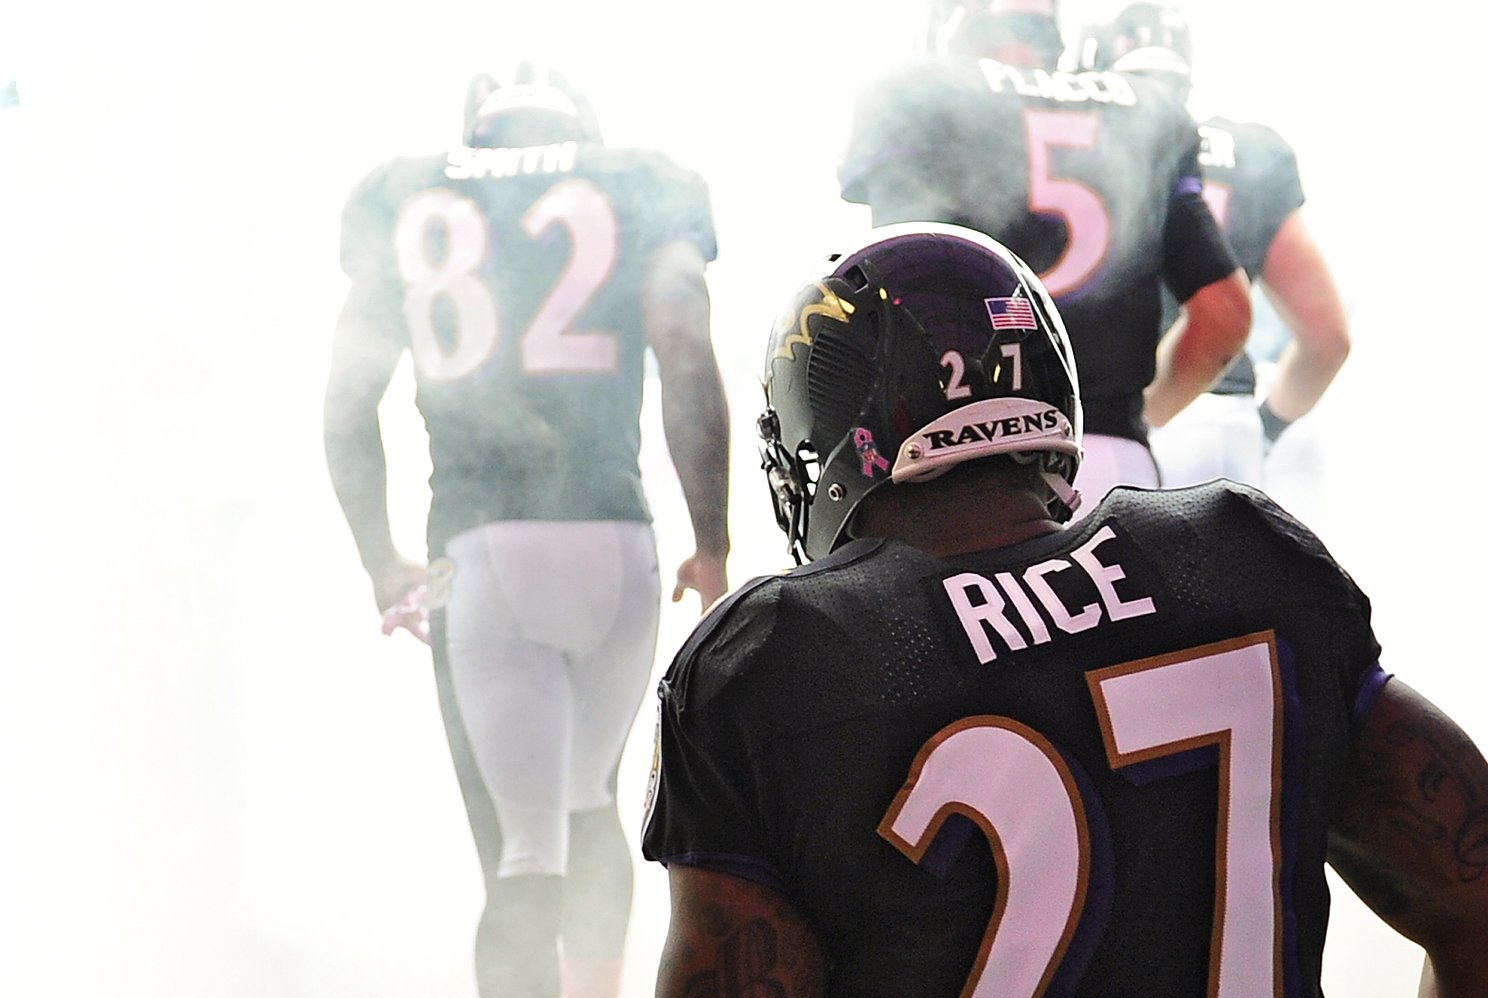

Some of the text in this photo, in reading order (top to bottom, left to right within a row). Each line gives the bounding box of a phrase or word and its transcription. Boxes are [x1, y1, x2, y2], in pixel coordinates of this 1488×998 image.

[444, 141, 577, 180] SMITH
[1021, 107, 1112, 299] 5
[395, 178, 618, 381] 82
[940, 343, 1022, 400] 27
[922, 410, 1060, 450] RAVENS
[941, 525, 1155, 664] RICE
